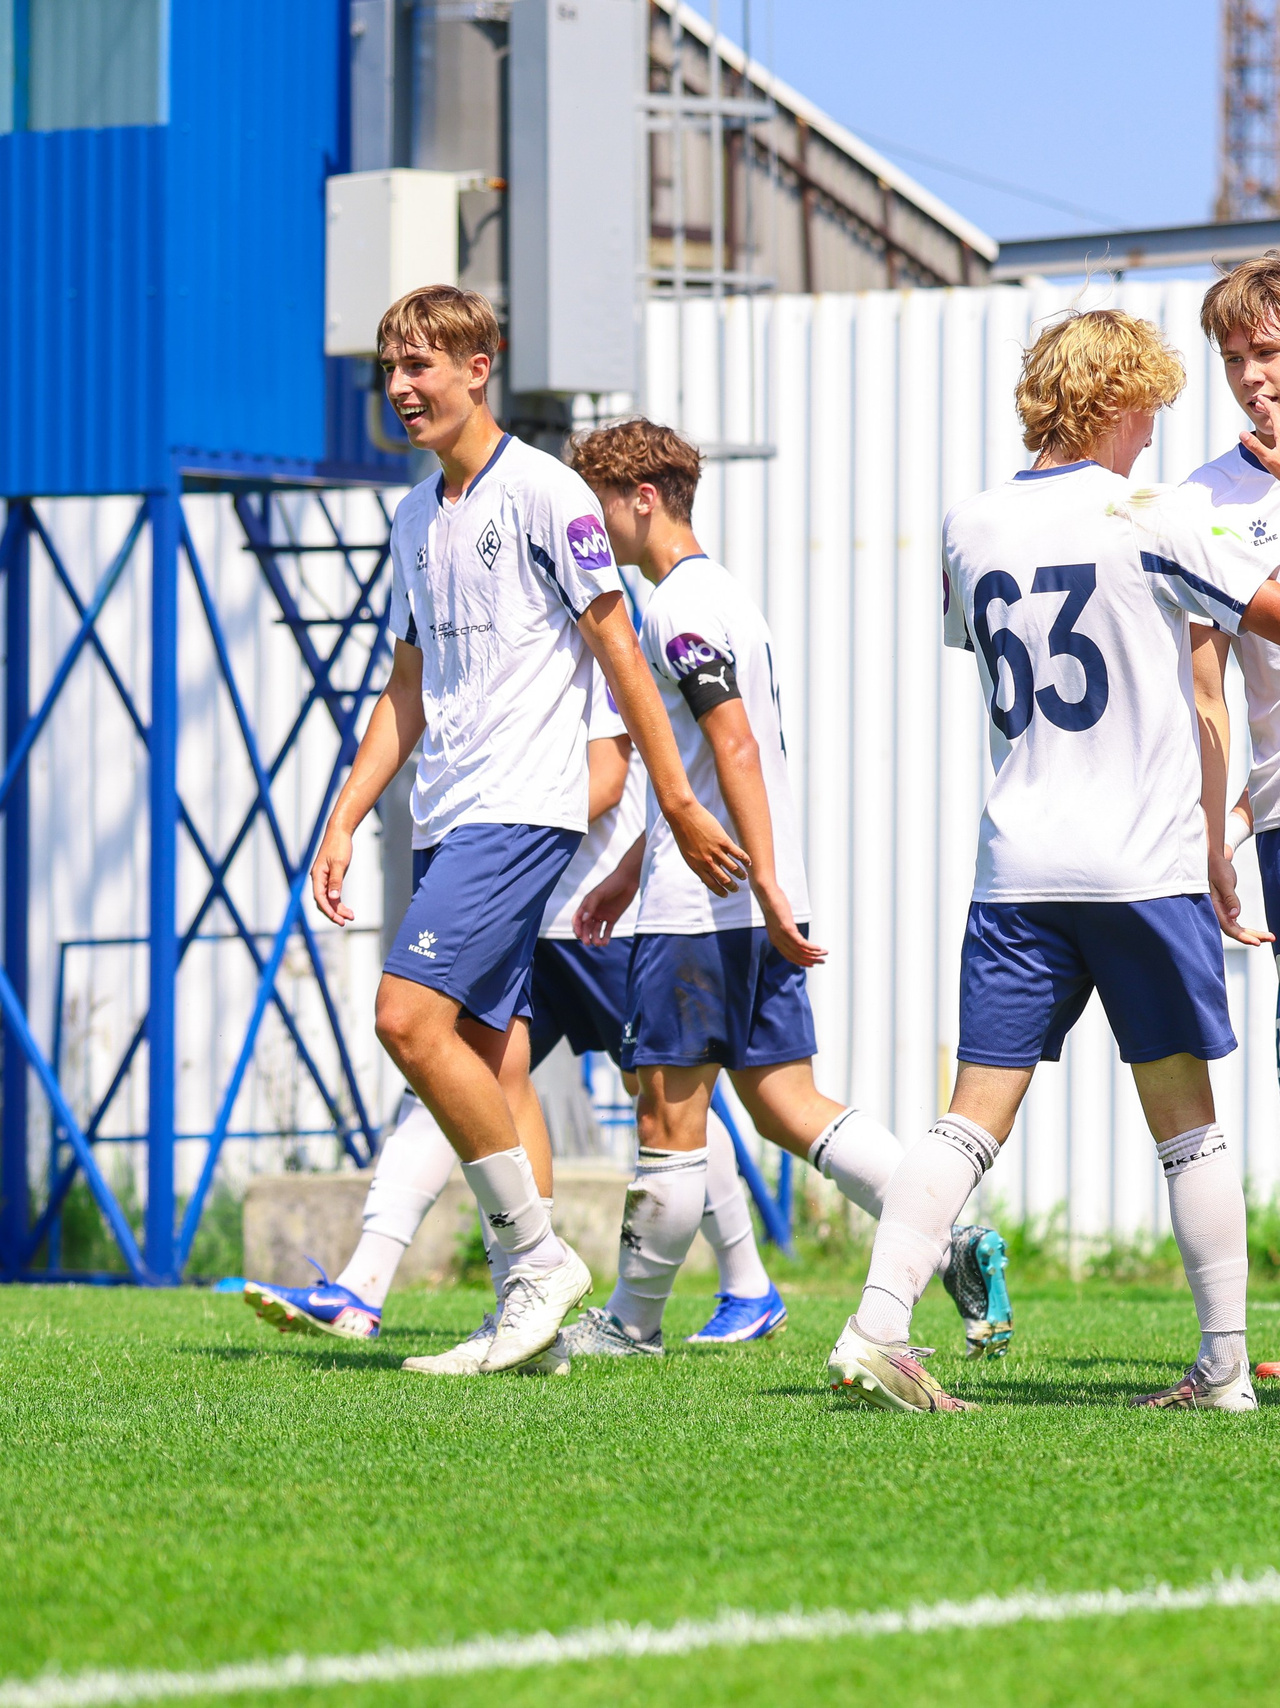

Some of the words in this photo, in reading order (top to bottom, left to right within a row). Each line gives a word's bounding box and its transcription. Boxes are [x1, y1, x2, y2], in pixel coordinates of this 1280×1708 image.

[571, 525, 608, 558] wb
[1250, 533, 1278, 547] ELME
[672, 640, 716, 675] wb
[973, 562, 1109, 741] 63
[408, 943, 437, 960] KELME
[1176, 1141, 1228, 1166] KELME
